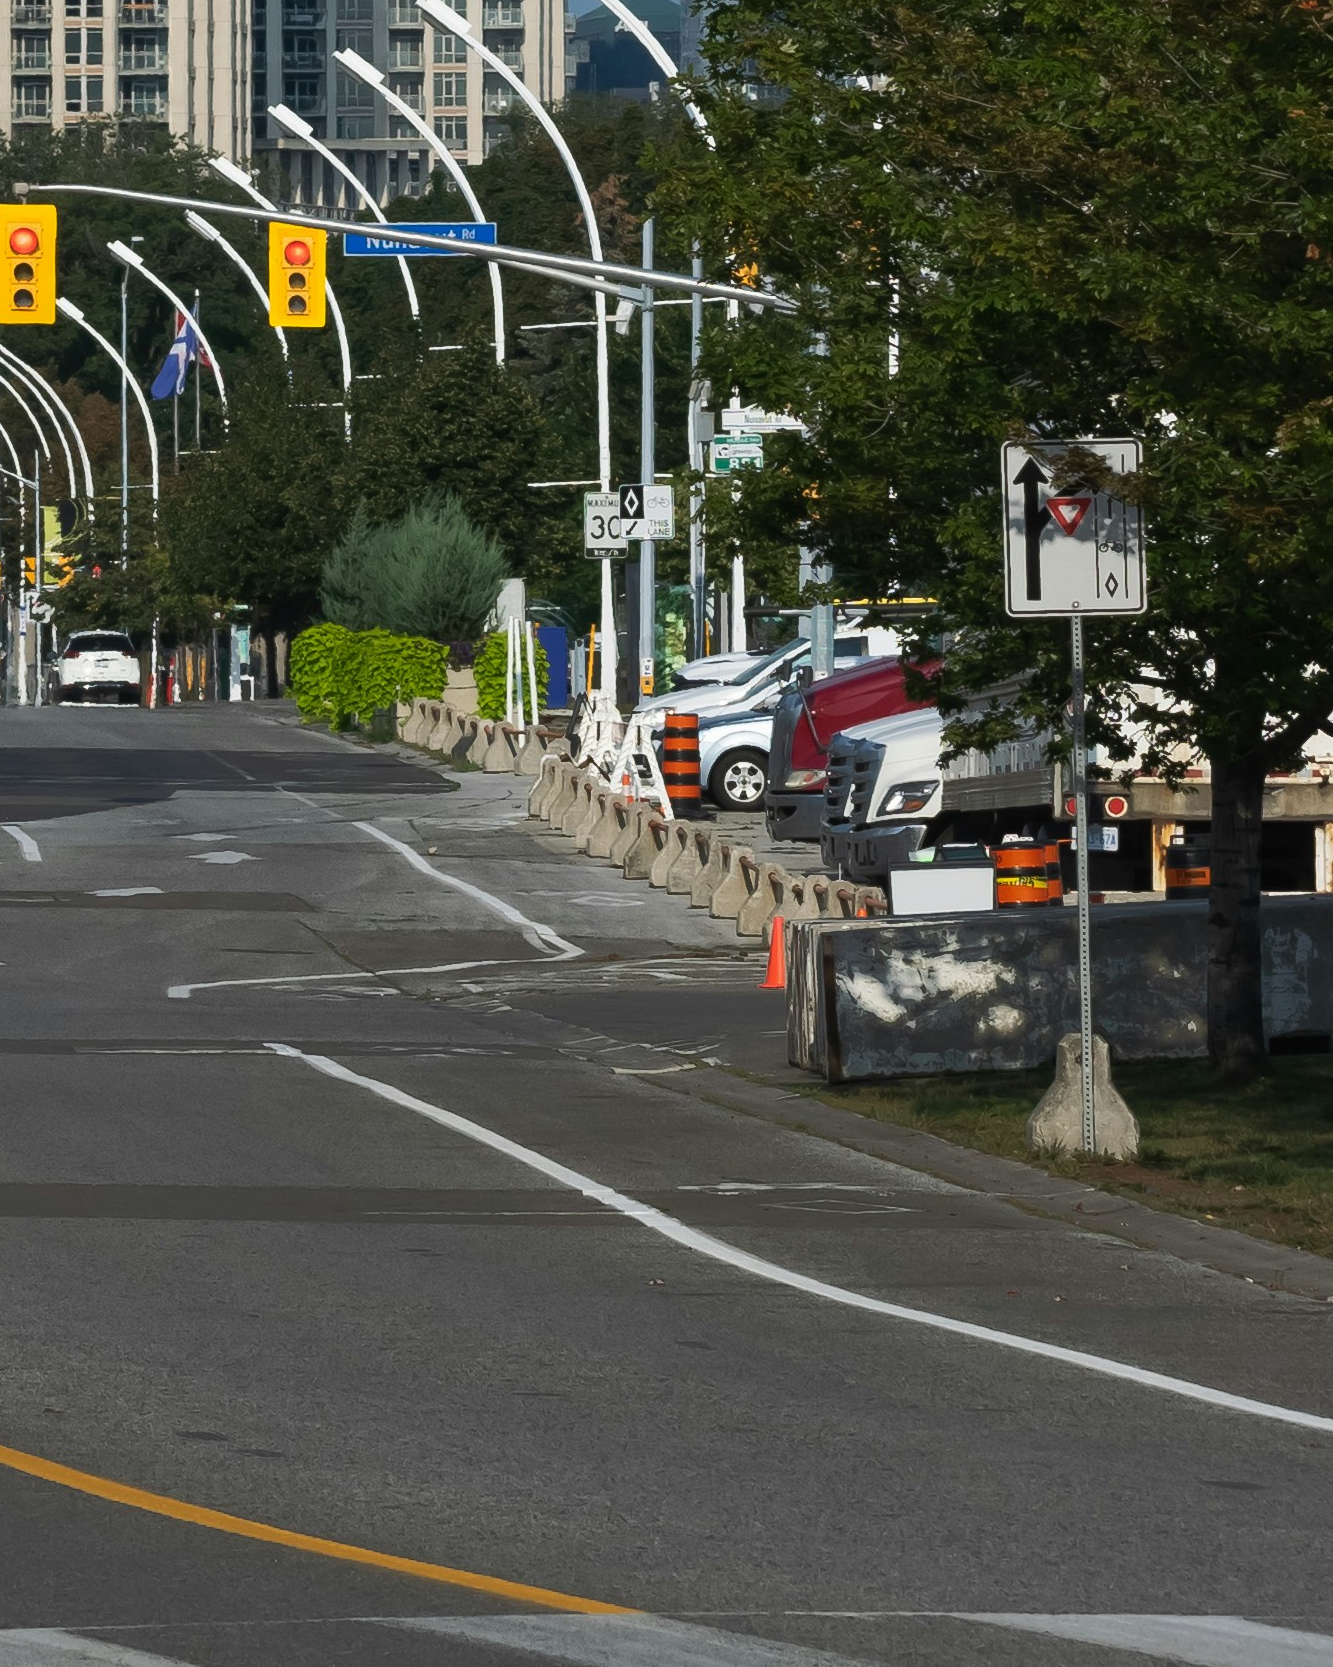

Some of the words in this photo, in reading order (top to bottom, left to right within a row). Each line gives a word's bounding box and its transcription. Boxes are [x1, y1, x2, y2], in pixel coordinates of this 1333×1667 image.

[462, 228, 475, 239] Rd
[588, 499, 620, 508] MAXIMU
[649, 519, 669, 527] THIS
[648, 528, 671, 536] LANE
